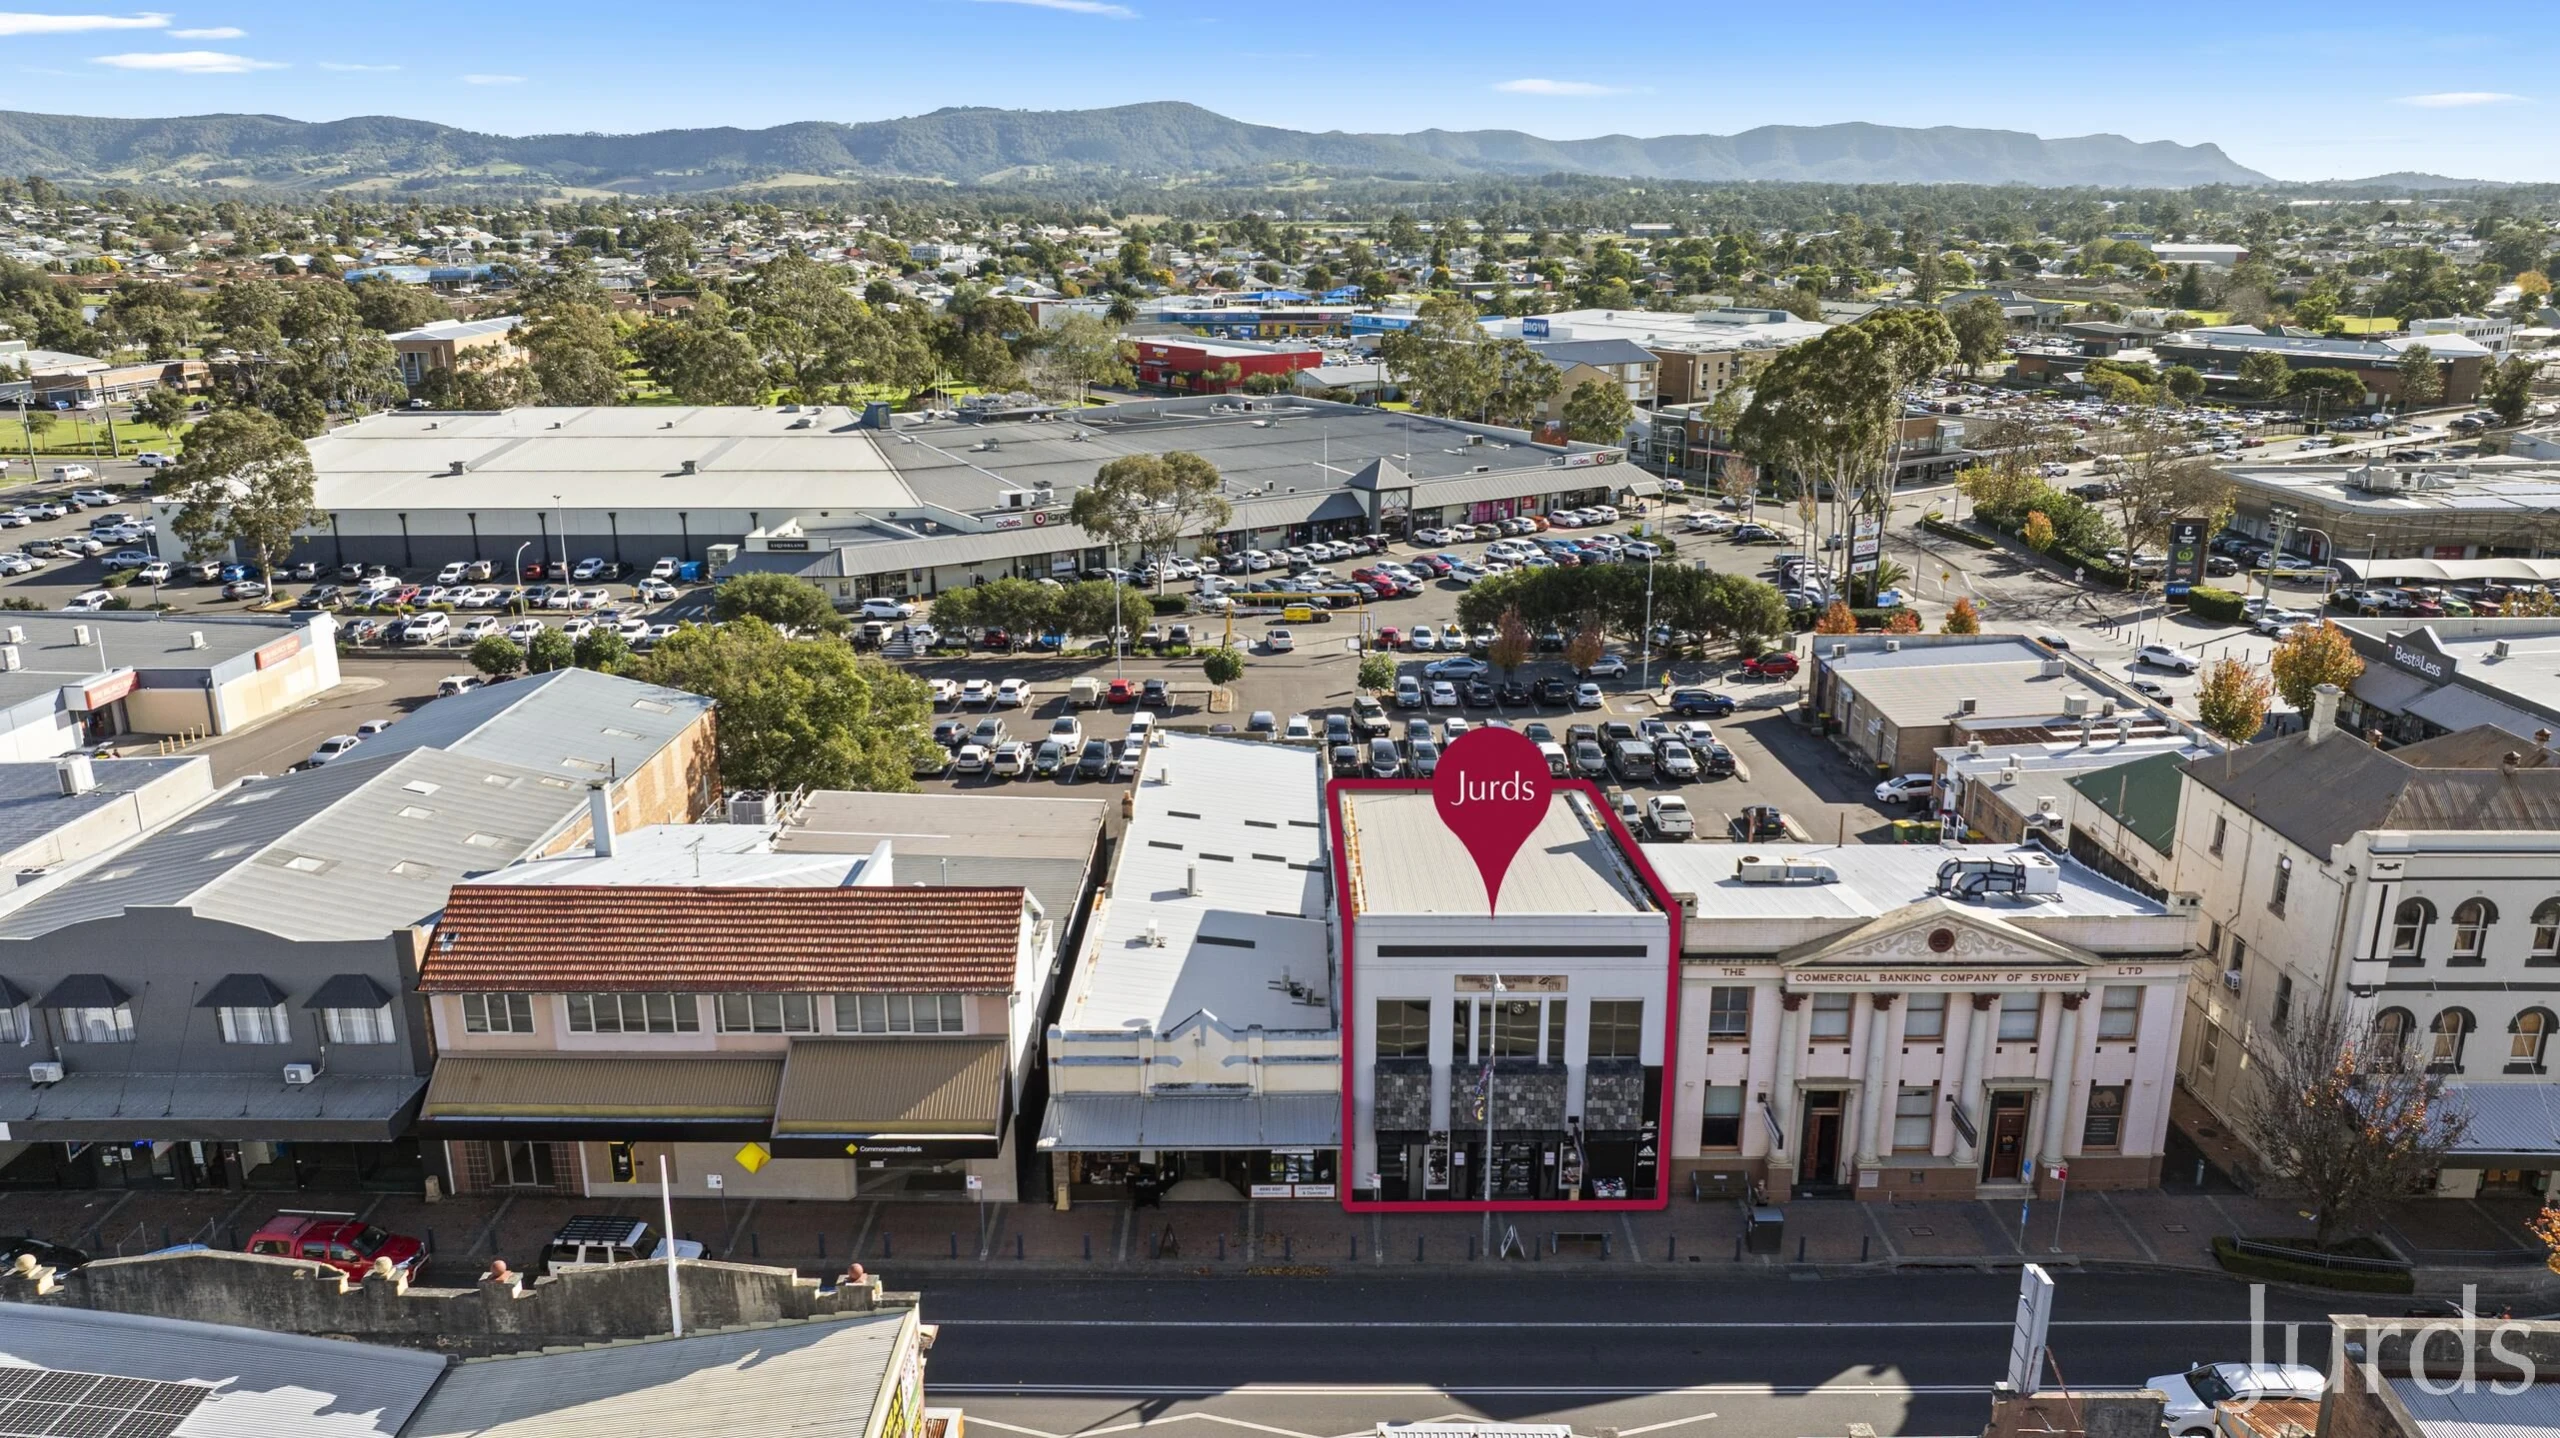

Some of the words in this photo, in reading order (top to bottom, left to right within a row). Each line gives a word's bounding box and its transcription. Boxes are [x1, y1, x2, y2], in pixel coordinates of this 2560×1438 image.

[996, 519, 1022, 529] coles
[1856, 543, 1876, 553] coles
[2395, 645, 2441, 677] Best&Less
[1722, 968, 1745, 976] THE
[2118, 967, 2142, 975] LTD
[1796, 973, 1871, 982] COMMERCIAL
[1941, 973, 1998, 982] COMPANY
[2006, 973, 2022, 982] OF
[2031, 973, 2080, 982] SYDNEY
